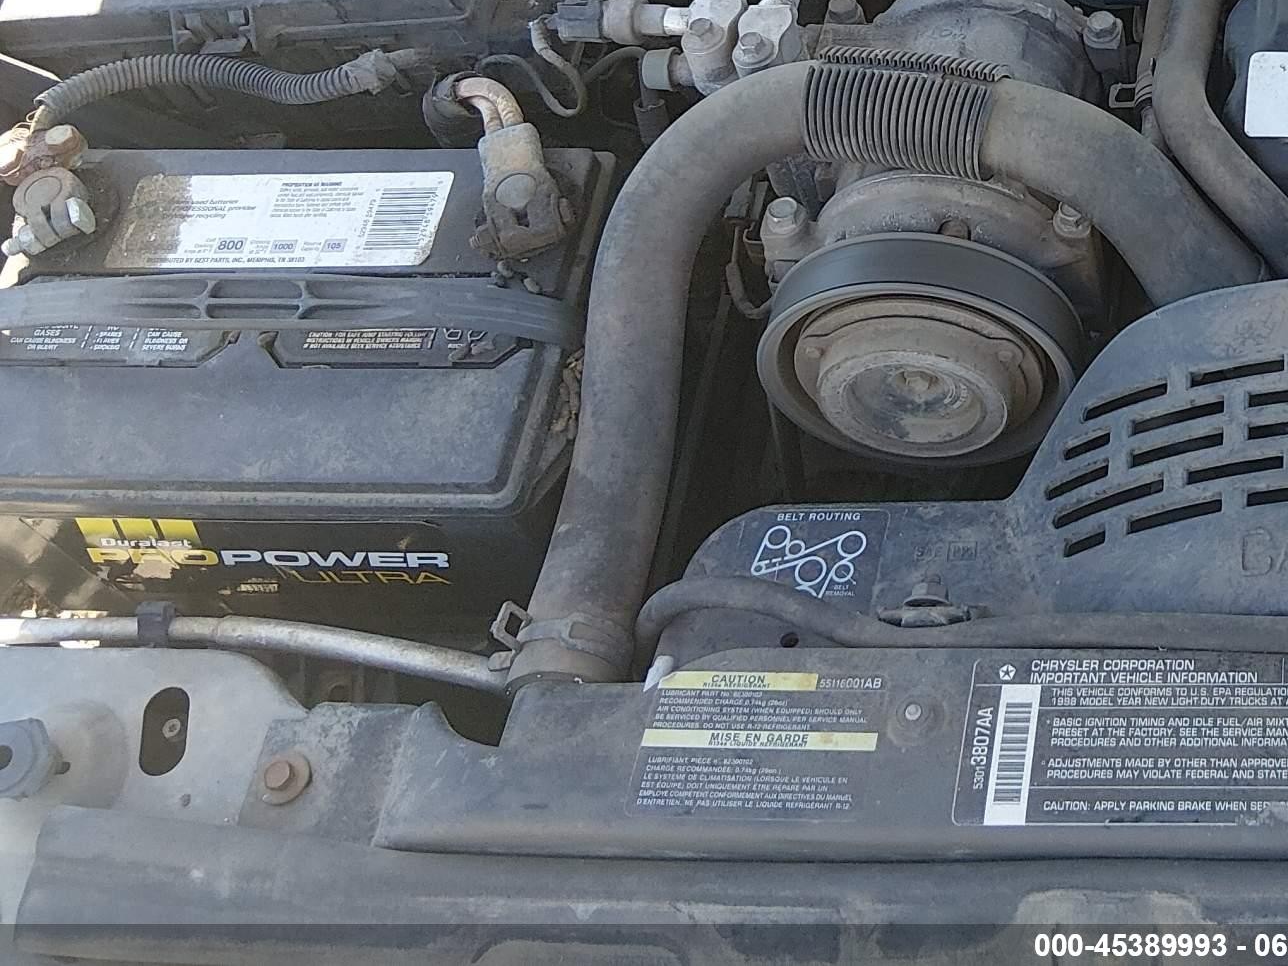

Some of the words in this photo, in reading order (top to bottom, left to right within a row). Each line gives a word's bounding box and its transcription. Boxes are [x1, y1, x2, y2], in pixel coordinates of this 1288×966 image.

[217, 240, 244, 251] 800
[273, 242, 294, 250] 1000
[777, 513, 804, 521] BELT
[809, 512, 861, 521] ROUTING
[100, 537, 193, 548] Duralast
[291, 571, 453, 585] ULTRA
[1031, 660, 1098, 671] CHRYSLER
[1103, 660, 1194, 671] CORPORATION
[711, 674, 766, 683] CAUTION
[1030, 672, 1106, 683] IMPORTANT
[1110, 672, 1162, 683] VEHICLE
[1167, 672, 1257, 683] INFORMATION
[1051, 687, 1073, 696] THIS
[1076, 687, 1114, 696] VEHICLE
[1117, 687, 1172, 696] CONFORMS
[1174, 687, 1187, 696] TO
[1190, 687, 1208, 696] U.S.
[1213, 687, 1231, 696] EPA
[1080, 697, 1113, 706] MODEL
[1116, 697, 1142, 706] YEAR
[1144, 697, 1169, 706] NEW
[1229, 697, 1268, 706] TRUCKS
[1270, 697, 1283, 706] AT
[1054, 718, 1082, 727] BASIC
[1084, 718, 1126, 727] IGNITION
[1130, 718, 1164, 727] TIMING
[1167, 718, 1189, 727] AND
[1192, 718, 1213, 727] IDLE
[709, 732, 740, 742] MISE
[745, 733, 761, 742] EN
[766, 733, 809, 743] GARDE
[1051, 728, 1089, 737] PRESET
[1091, 728, 1104, 737] AT
[1107, 728, 1125, 737] THE
[1179, 728, 1197, 737] SEE
[1200, 728, 1219, 737] THE
[1222, 728, 1262, 737] SERVICE
[1050, 738, 1116, 747] PROCEDURES
[1119, 738, 1140, 747] AND
[1144, 738, 1176, 747] OTHER
[1180, 738, 1238, 747] ADDITIONAL
[1047, 759, 1121, 768] ADJUSTMENTS
[1124, 759, 1154, 768] MADE
[1157, 759, 1171, 768] BY
[1174, 759, 1206, 768] OTHER
[1210, 758, 1237, 768] THAN
[1046, 770, 1112, 779] PROCEDURES
[1116, 770, 1139, 779] MAY
[1142, 770, 1182, 779] VIOLATE
[1185, 769, 1228, 779] FEDERAL
[1232, 769, 1254, 779] AND
[1257, 769, 1288, 779] STATE
[1043, 801, 1090, 811] CAUTION:
[1093, 801, 1126, 811] APPLY
[1129, 801, 1174, 811] PARKING
[1177, 801, 1211, 810] BRAKE
[1214, 801, 1246, 810] WHEN
